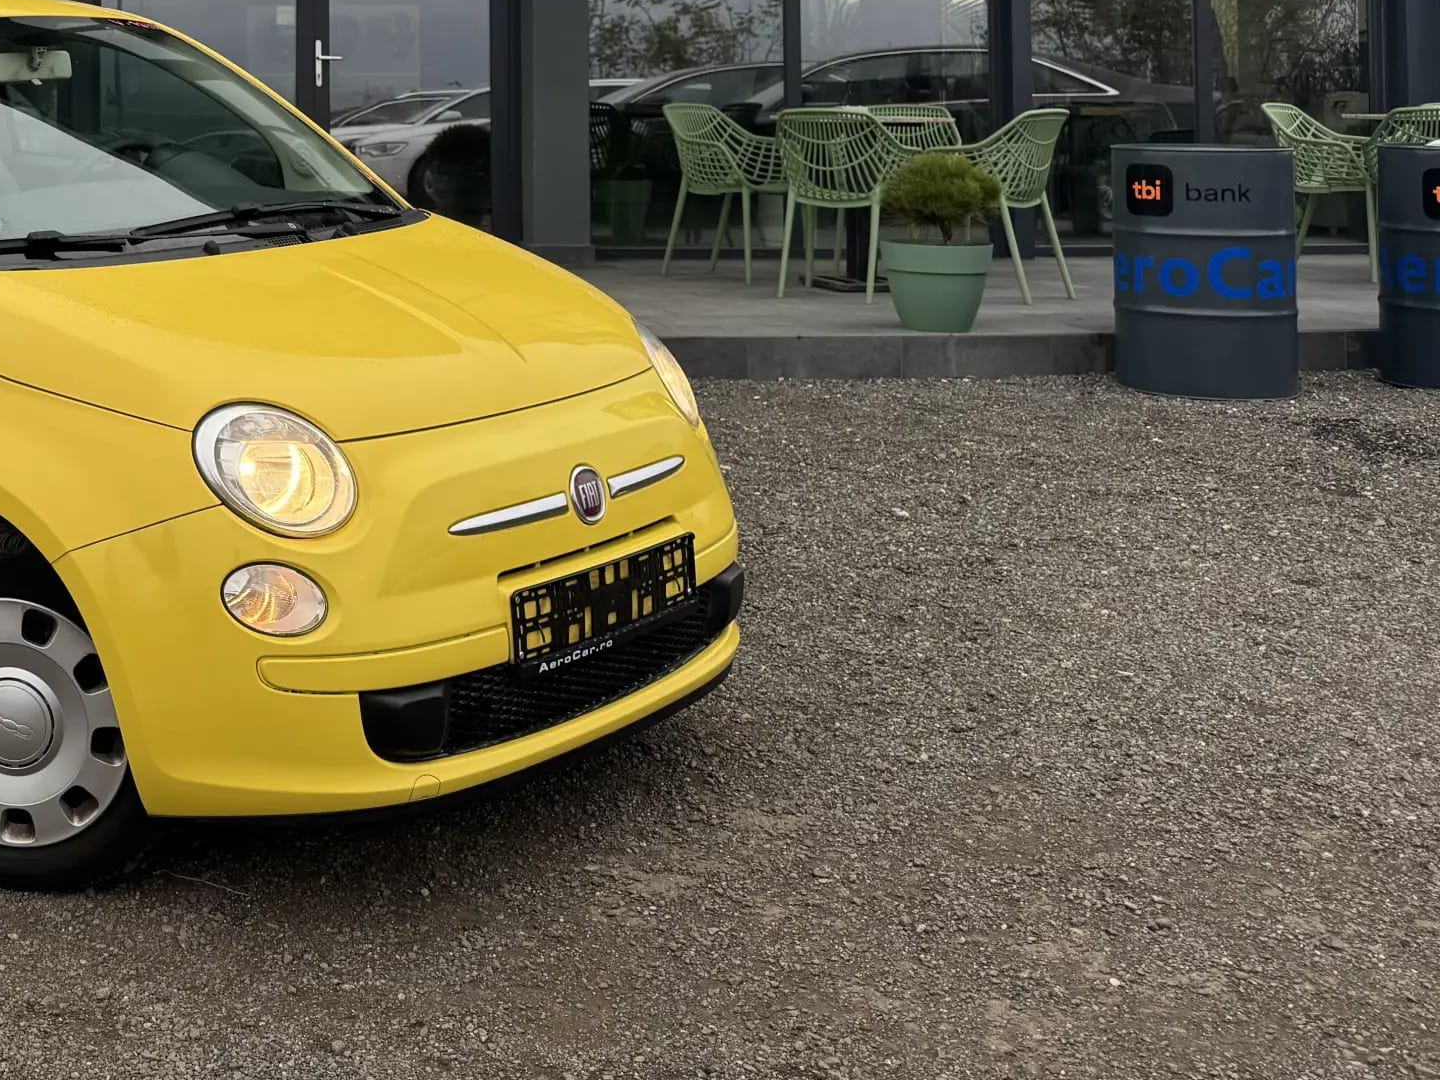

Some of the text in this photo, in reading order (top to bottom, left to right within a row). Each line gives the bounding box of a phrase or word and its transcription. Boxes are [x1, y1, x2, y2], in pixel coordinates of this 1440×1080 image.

[1132, 179, 1252, 203] tbi bank
[578, 480, 600, 510] FIAT
[538, 639, 613, 674] AeroCar.ro
